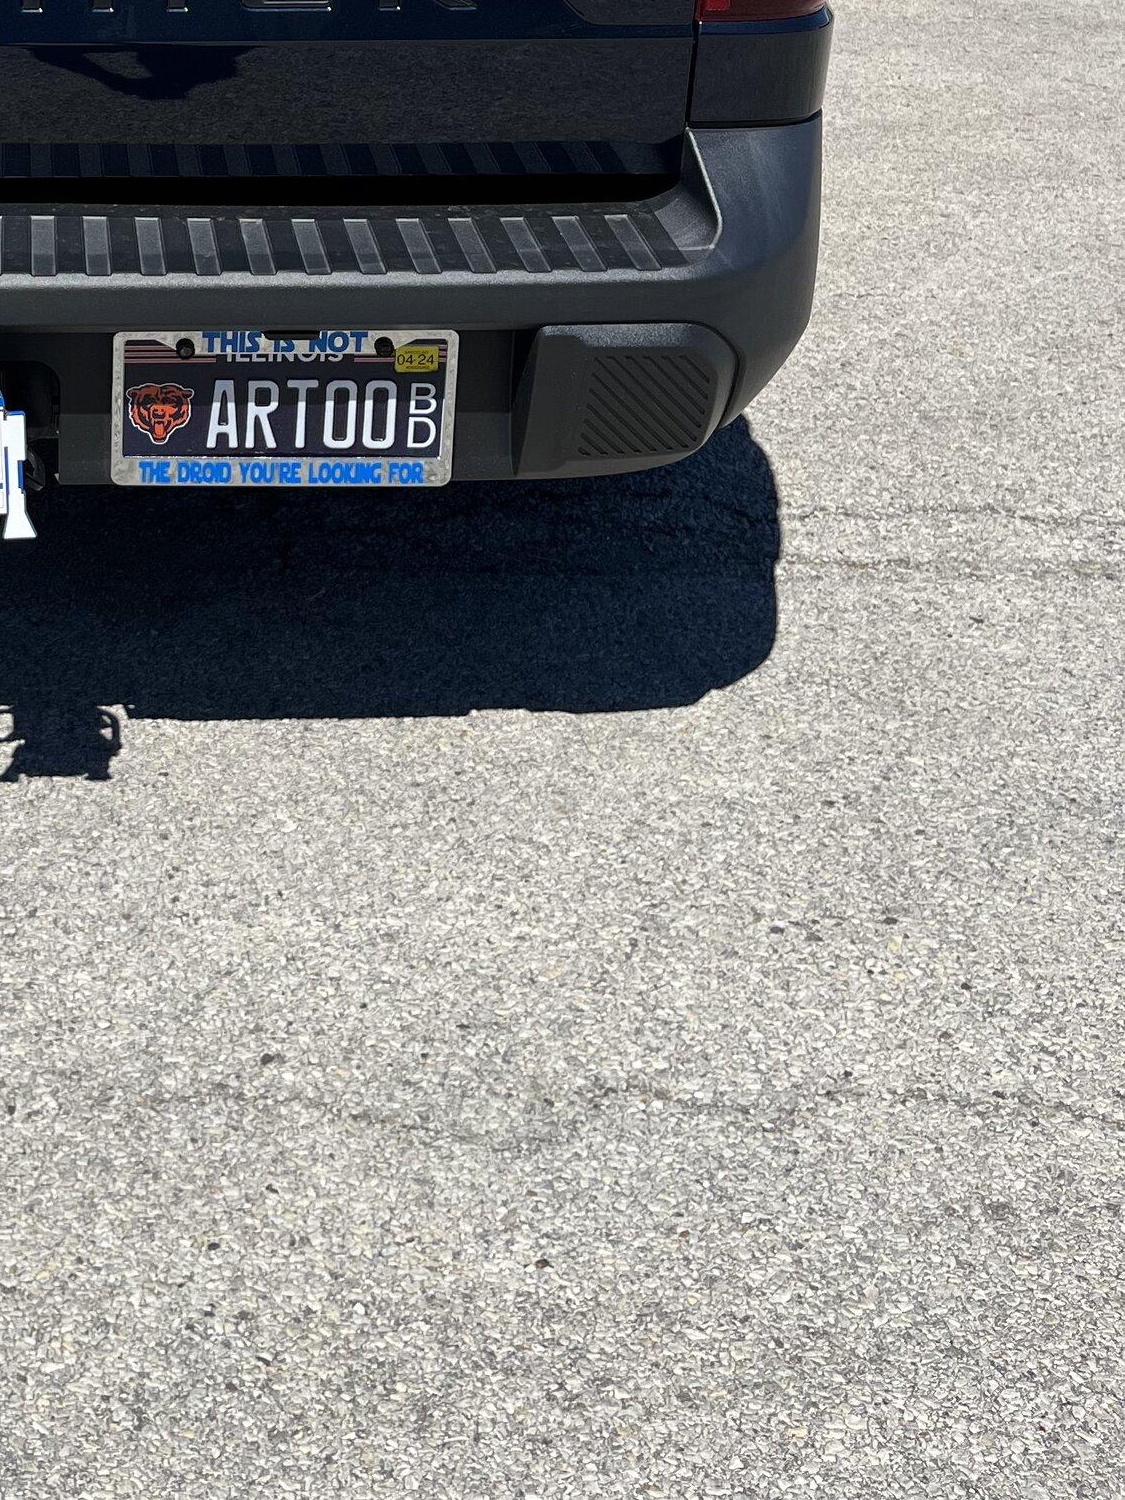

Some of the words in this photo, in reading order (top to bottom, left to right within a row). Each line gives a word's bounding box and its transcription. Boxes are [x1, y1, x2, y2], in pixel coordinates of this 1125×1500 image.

[202, 331, 262, 353] THIS
[308, 331, 369, 353] NOT
[409, 382, 437, 415] B
[407, 416, 436, 448] D
[138, 461, 171, 484] THE
[177, 461, 232, 484] DROID
[239, 461, 301, 484] YOU'RE
[308, 461, 382, 484] LOOKING
[388, 461, 424, 484] FOR
